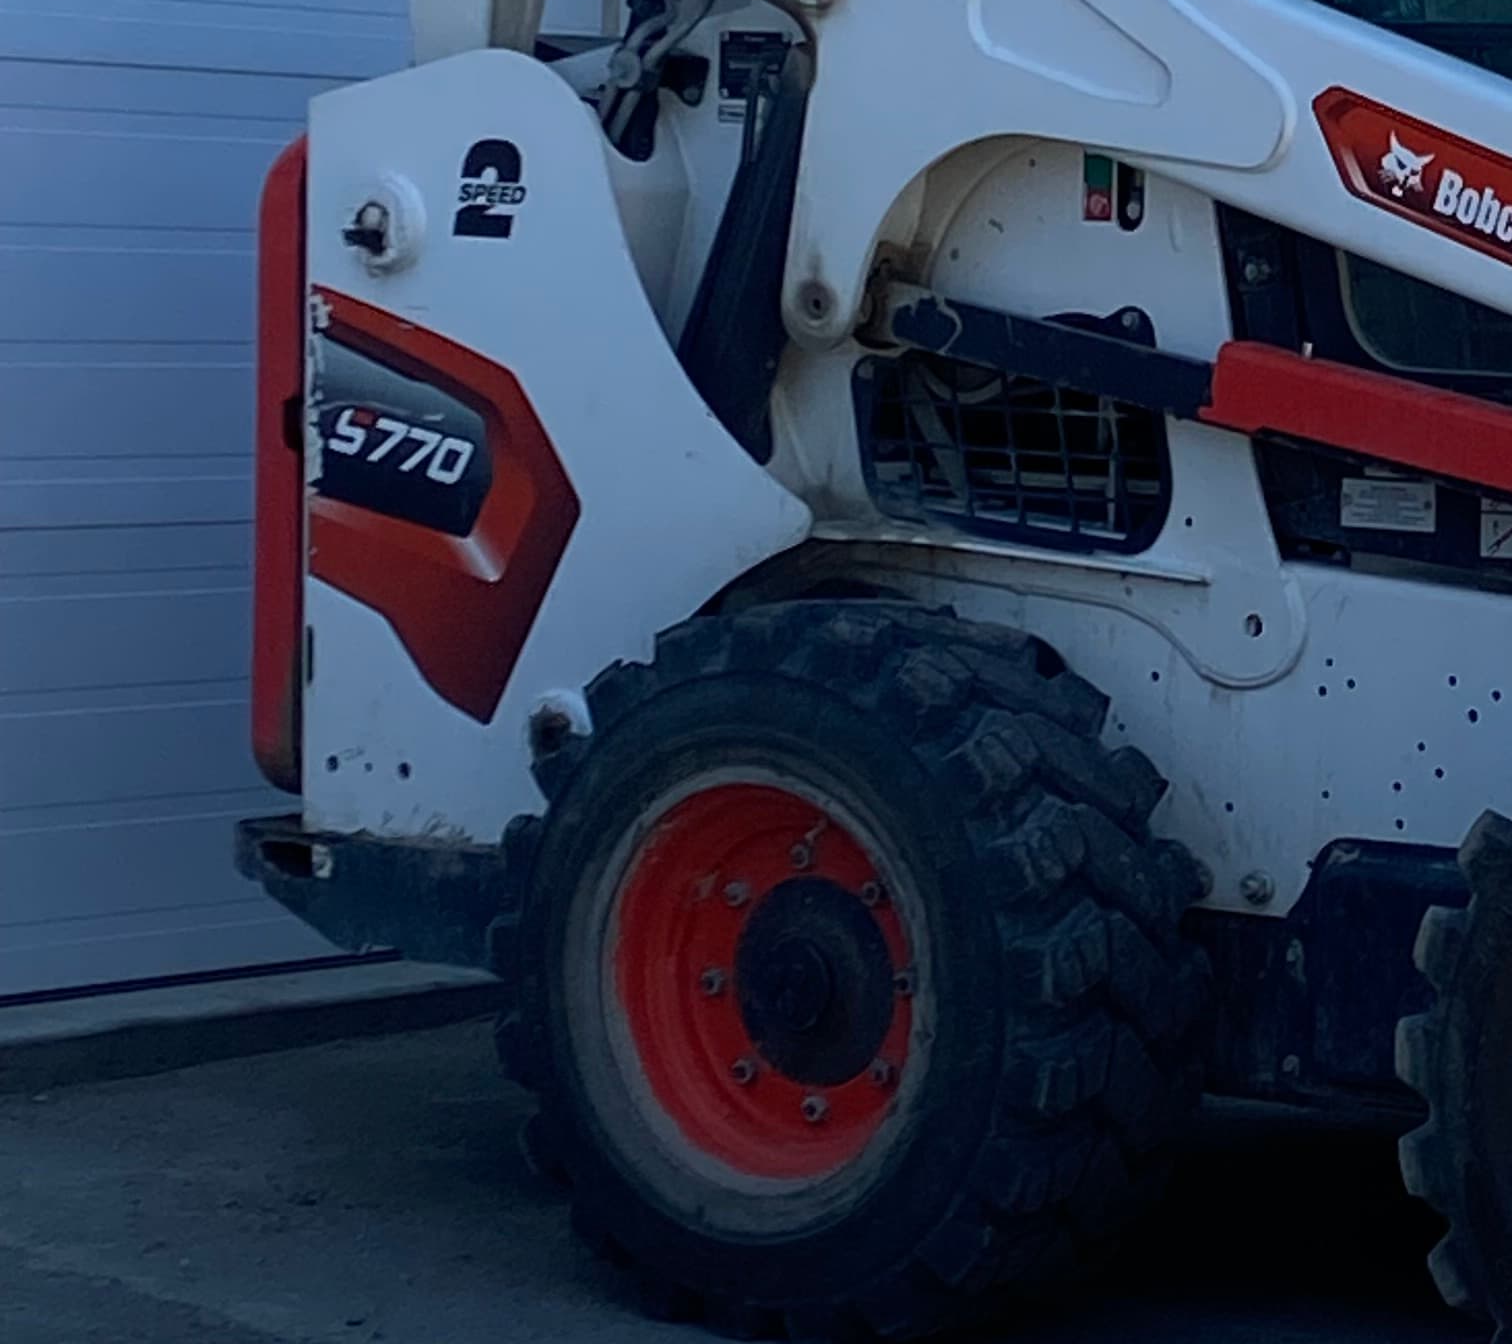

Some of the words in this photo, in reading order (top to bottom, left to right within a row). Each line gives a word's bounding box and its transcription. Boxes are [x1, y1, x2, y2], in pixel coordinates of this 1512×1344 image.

[452, 138, 522, 239] 2
[458, 183, 527, 205] SPEED
[328, 407, 475, 485] S770
